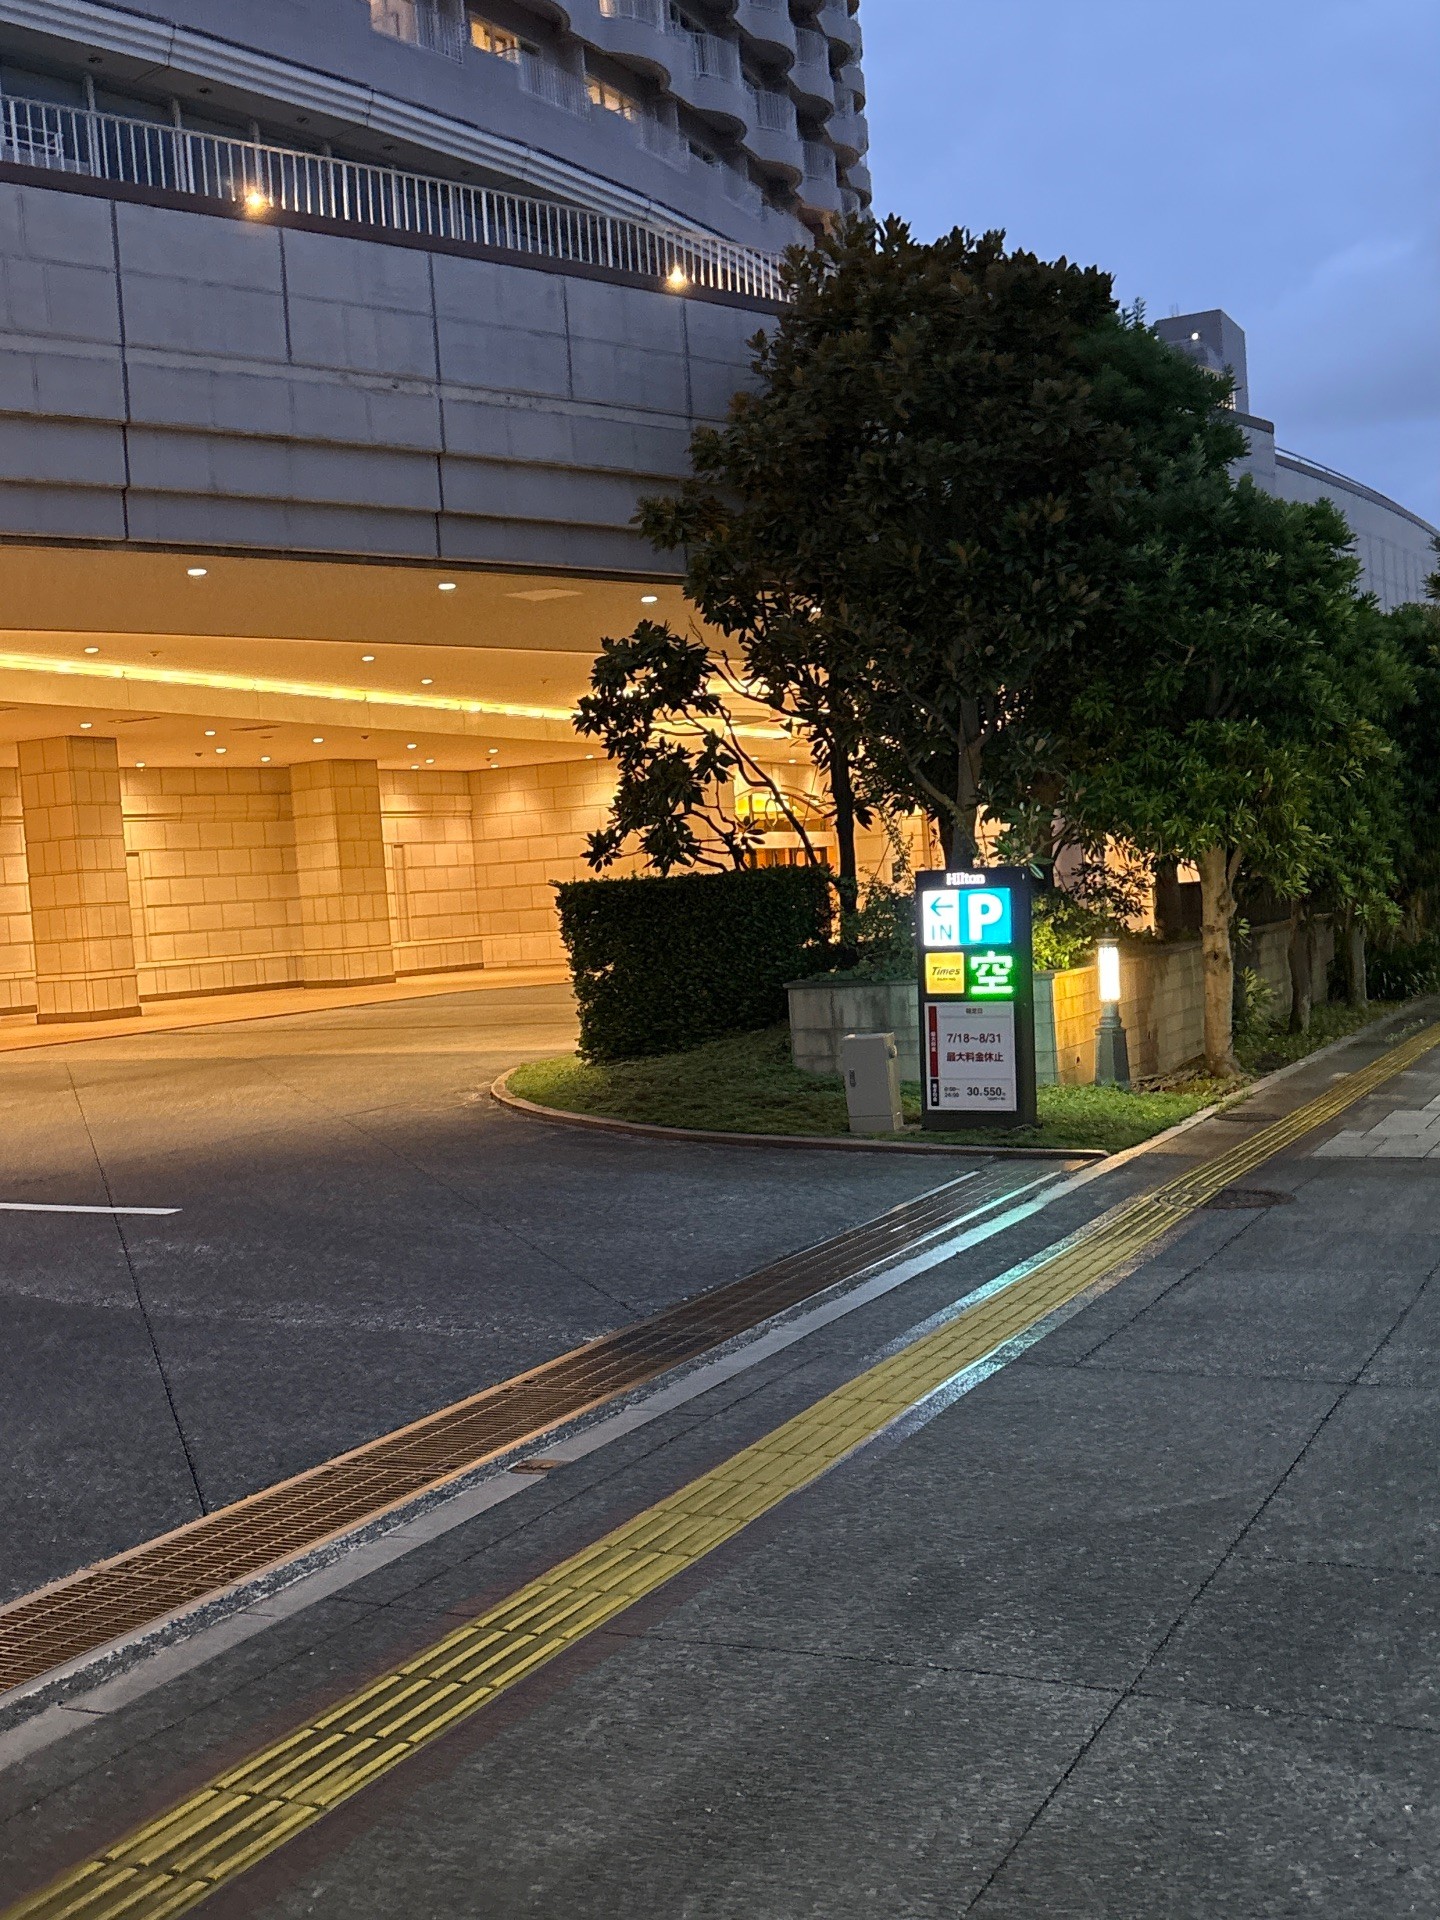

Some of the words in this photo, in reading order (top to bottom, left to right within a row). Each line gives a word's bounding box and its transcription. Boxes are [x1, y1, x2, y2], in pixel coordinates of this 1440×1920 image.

[946, 872, 986, 886] Hilton
[967, 893, 1003, 942] P
[932, 924, 952, 940] IN
[931, 966, 961, 976] Times
[970, 950, 1014, 994] 空
[946, 1052, 1004, 1062] 最大料金休止
